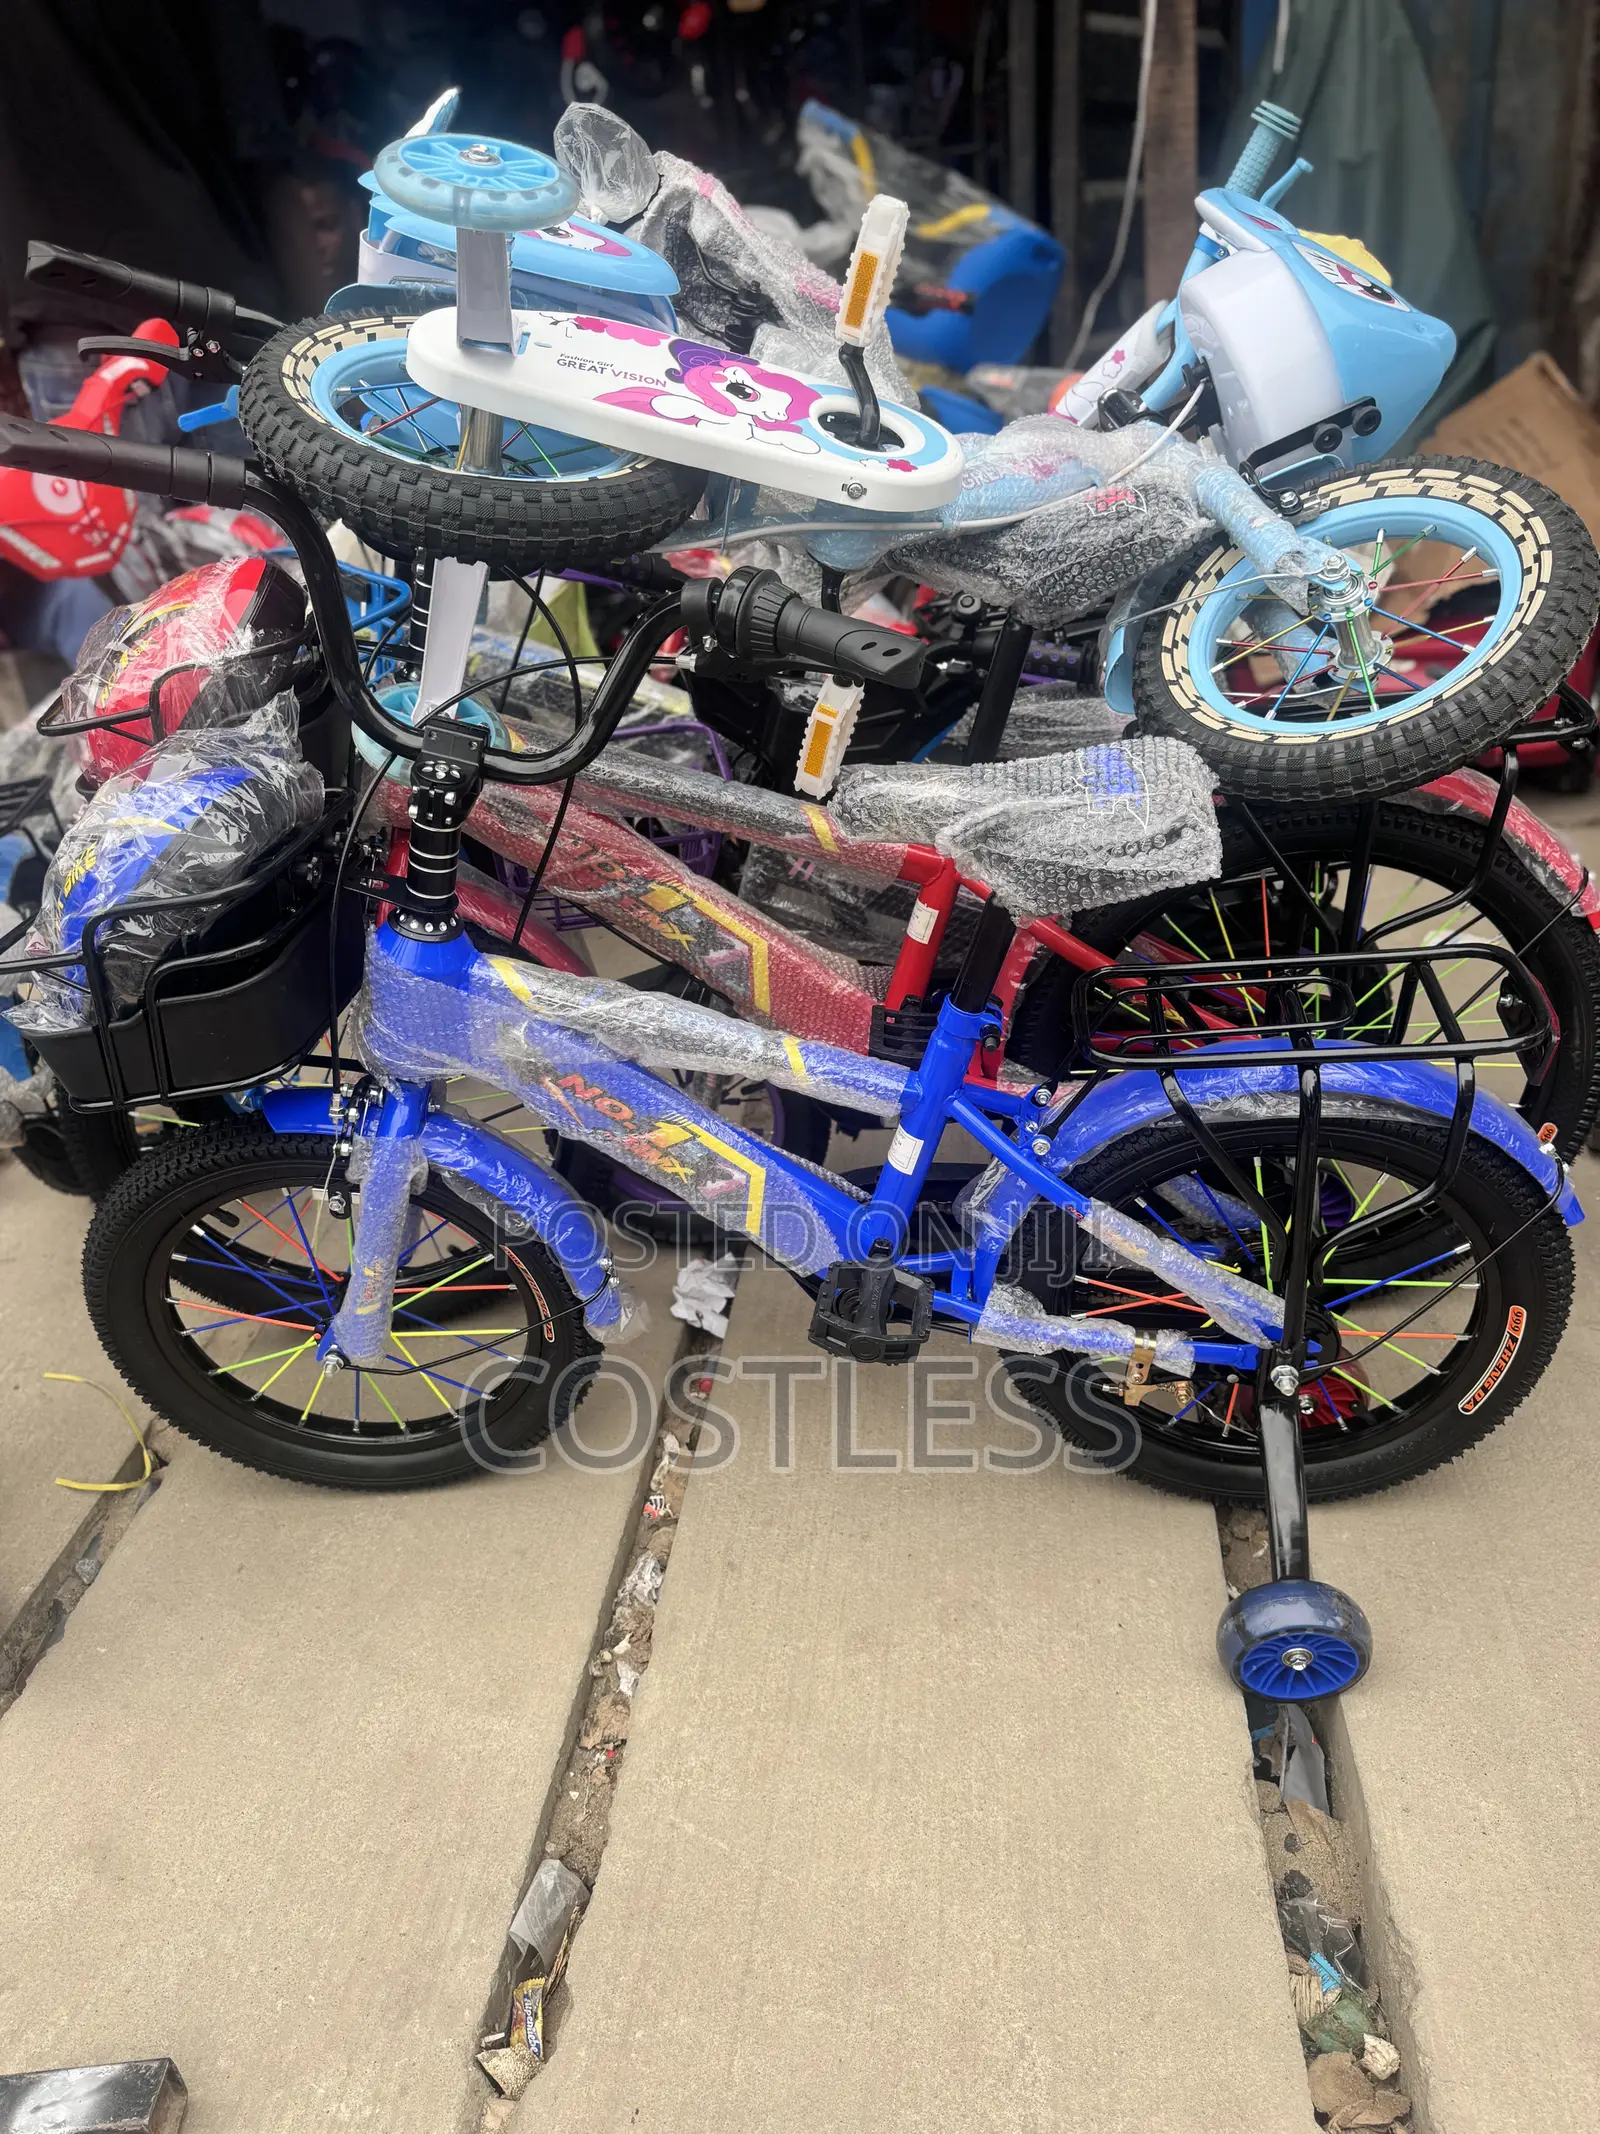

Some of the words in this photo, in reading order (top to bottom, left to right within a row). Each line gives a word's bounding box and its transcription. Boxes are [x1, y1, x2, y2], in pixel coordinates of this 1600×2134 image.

[560, 353, 595, 364] Fashion
[597, 360, 614, 368] Girl
[556, 358, 607, 375] GREAT
[611, 369, 667, 387] VISION
